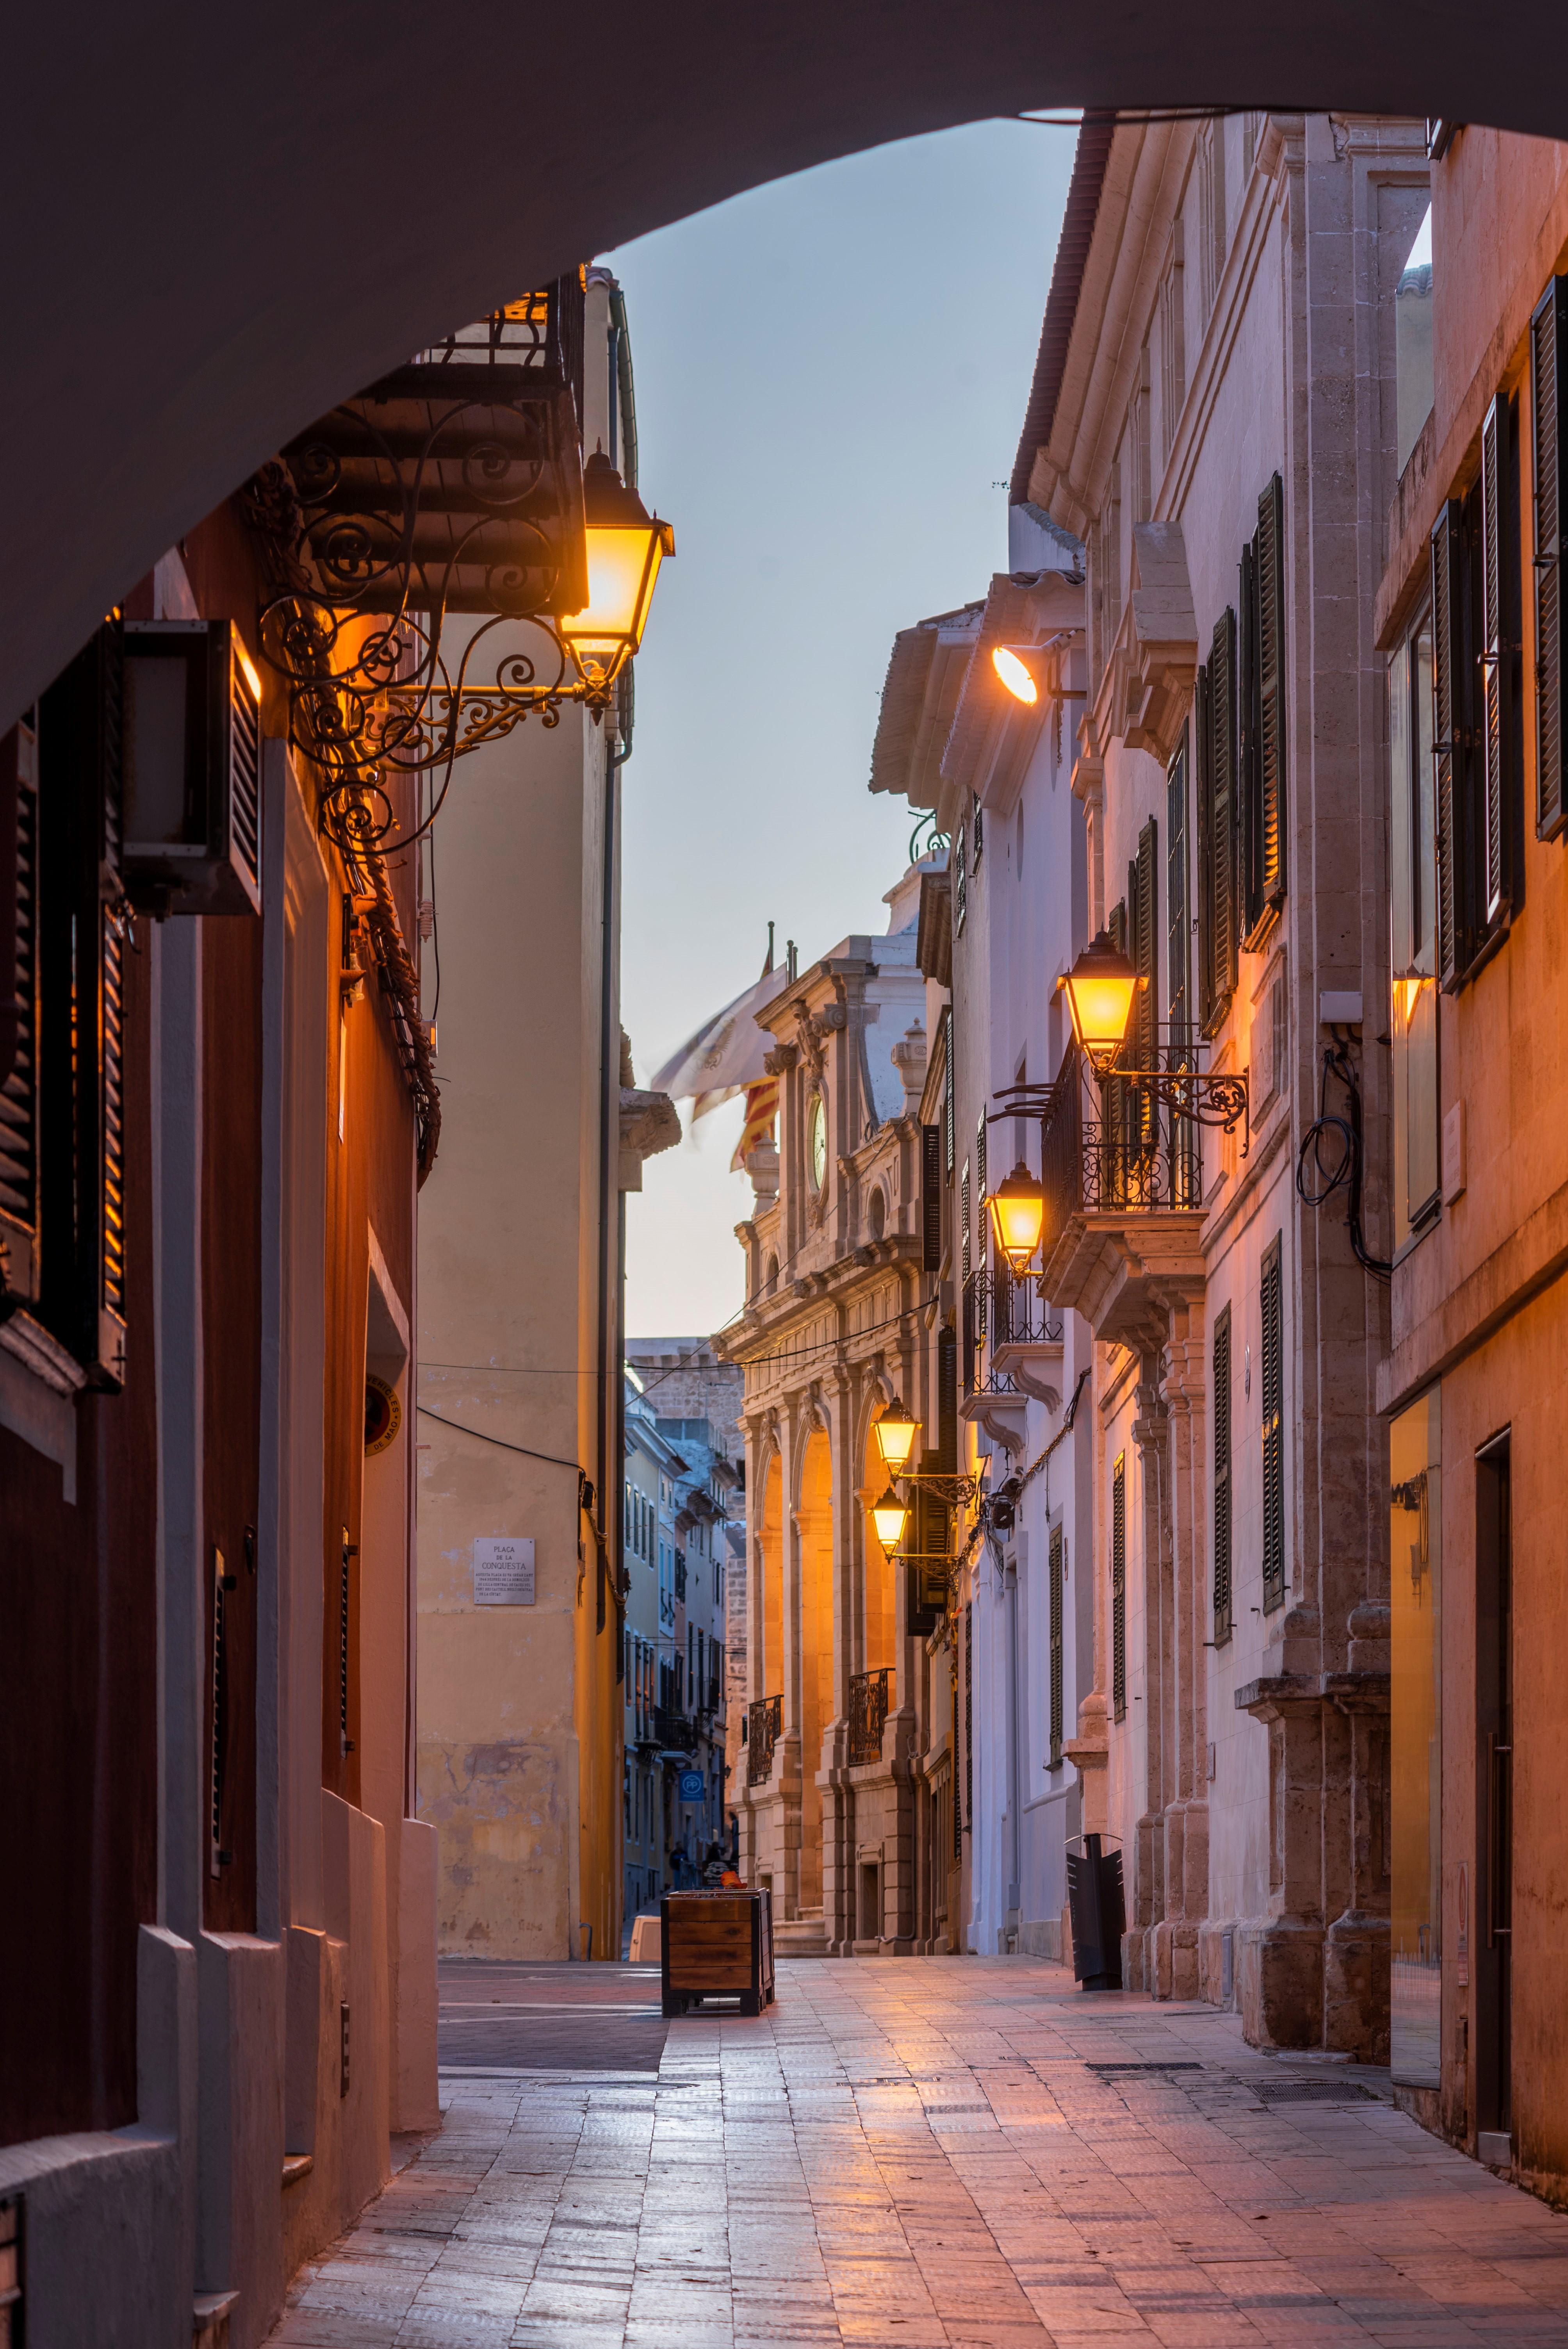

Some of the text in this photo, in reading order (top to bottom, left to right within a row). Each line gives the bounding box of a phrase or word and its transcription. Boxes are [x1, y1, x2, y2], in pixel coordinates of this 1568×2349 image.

[367, 1376, 399, 1413] VEHICLES
[374, 1421, 397, 1450] DE MAO
